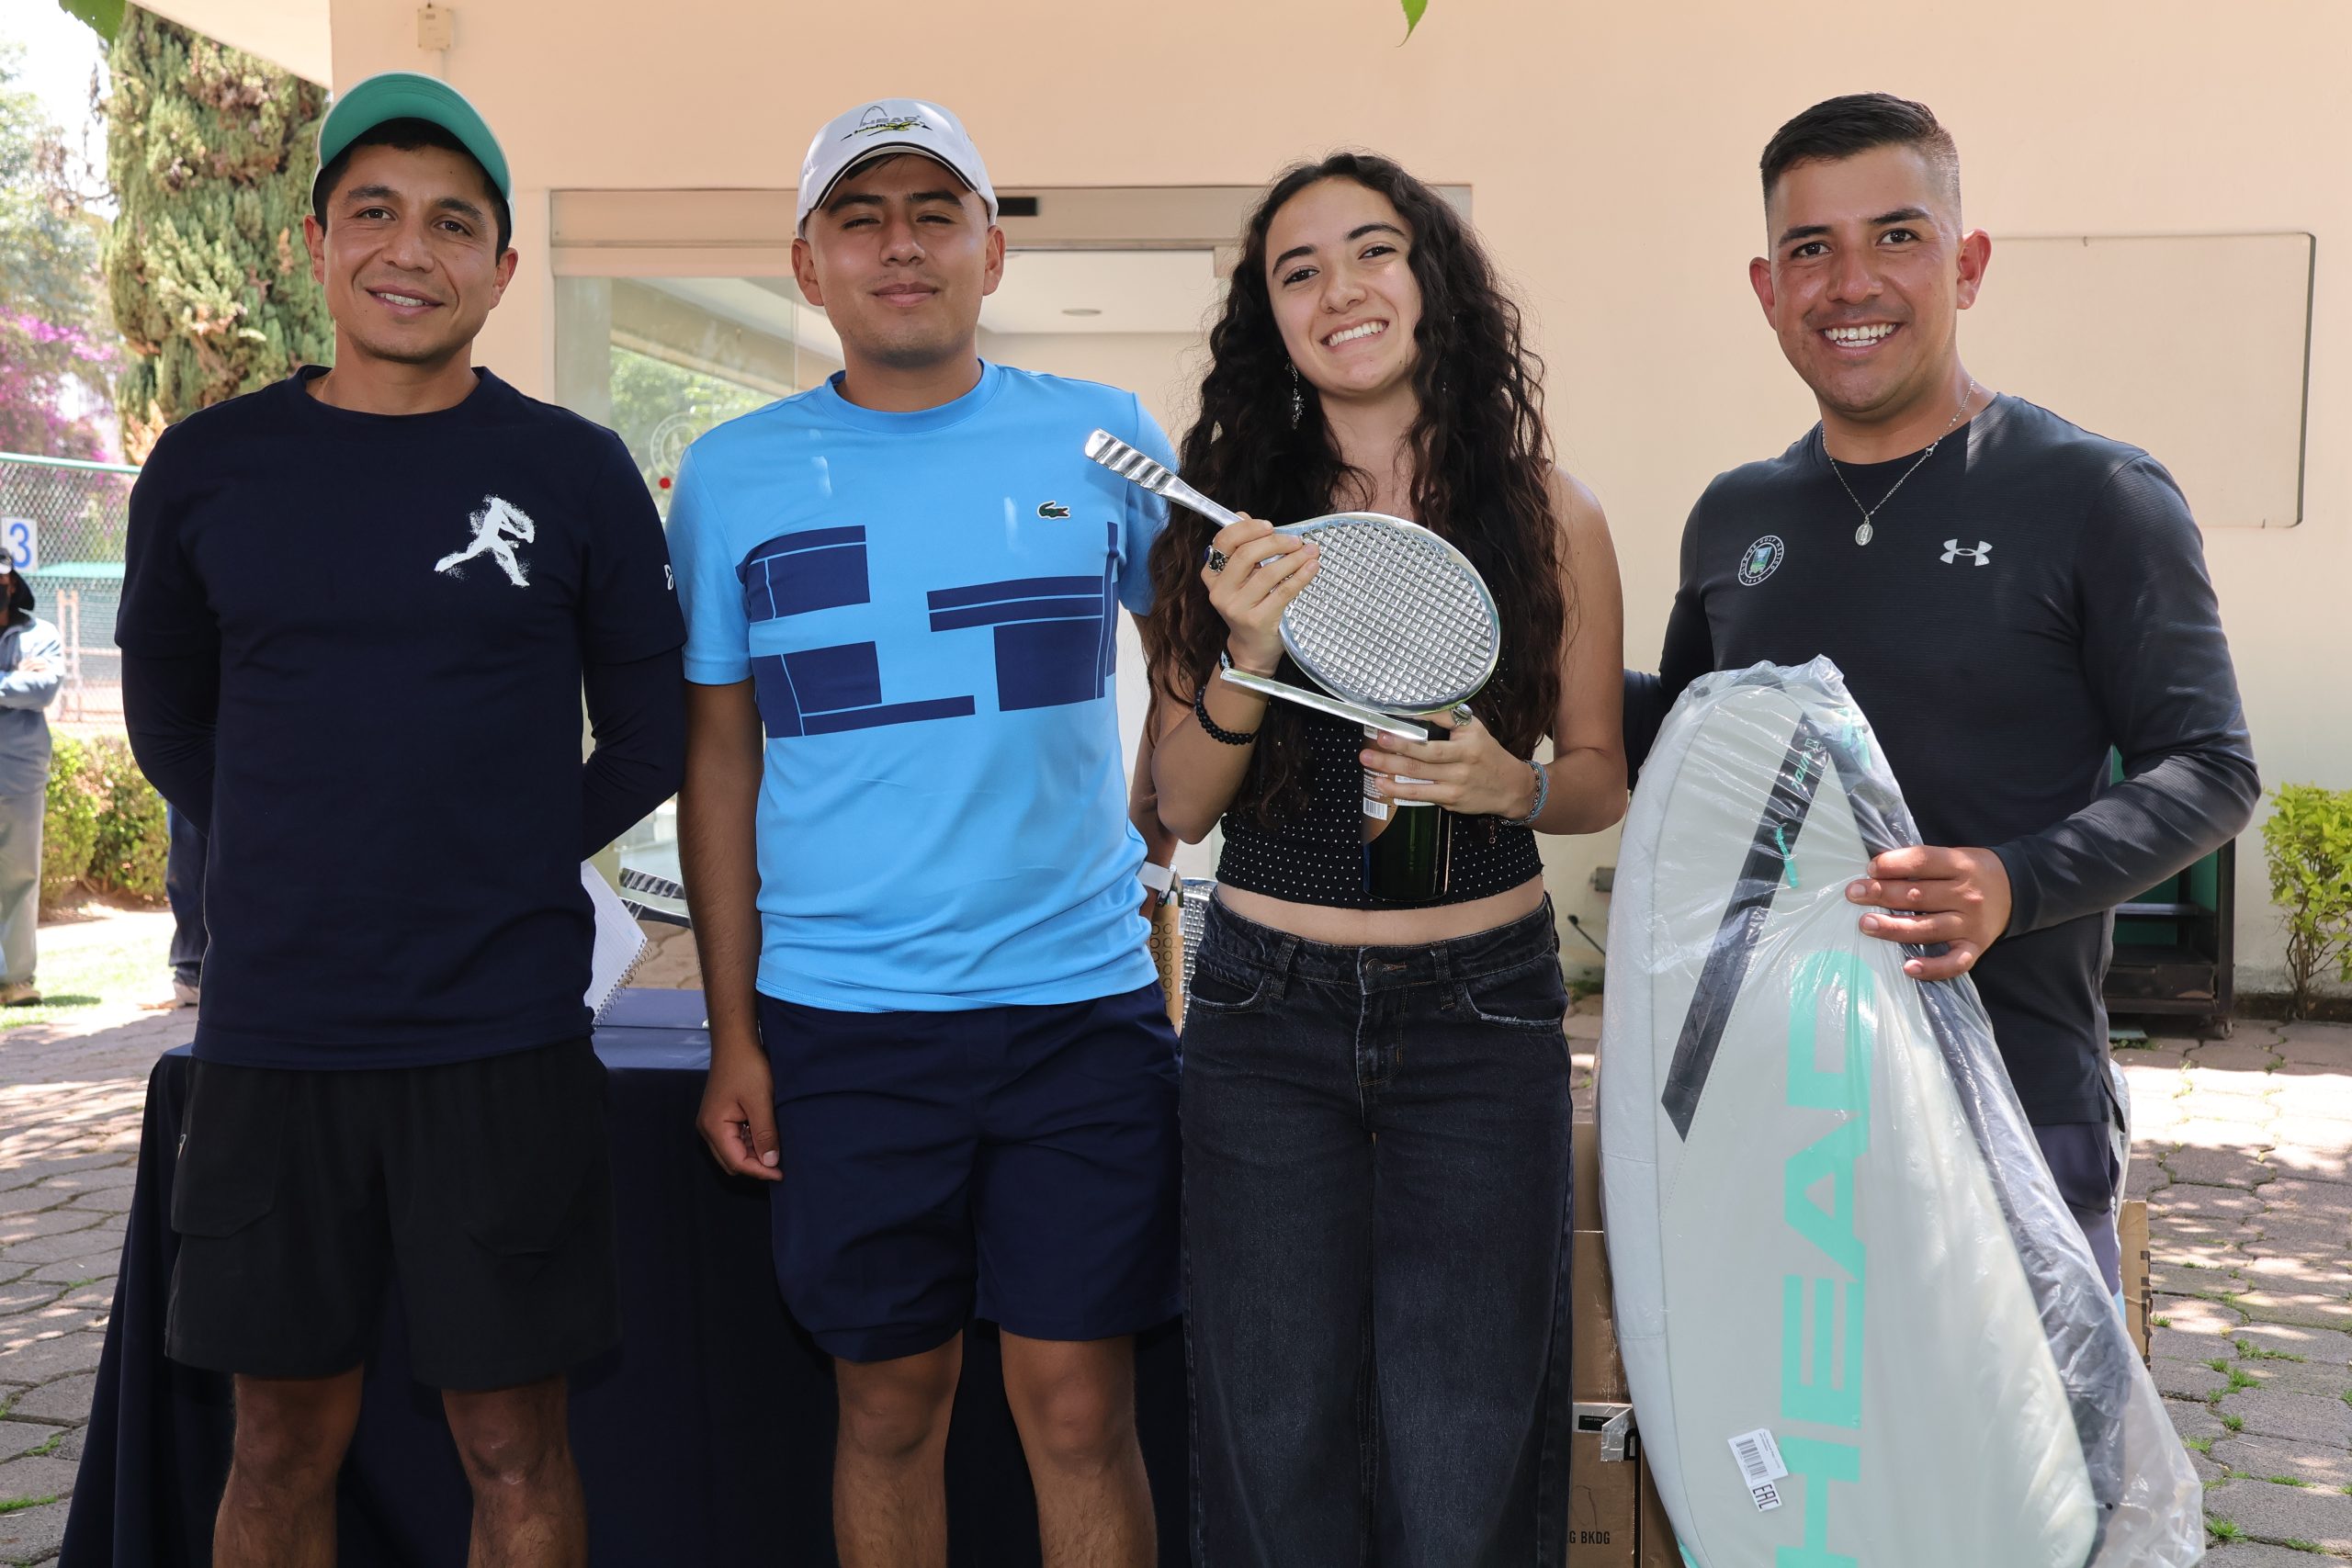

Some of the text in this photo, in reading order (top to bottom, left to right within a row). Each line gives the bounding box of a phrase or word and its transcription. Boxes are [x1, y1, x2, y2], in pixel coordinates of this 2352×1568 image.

[9, 523, 31, 568] 3
[1776, 950, 1875, 1567] HEAD
[1580, 1530, 1611, 1545] BKDG
